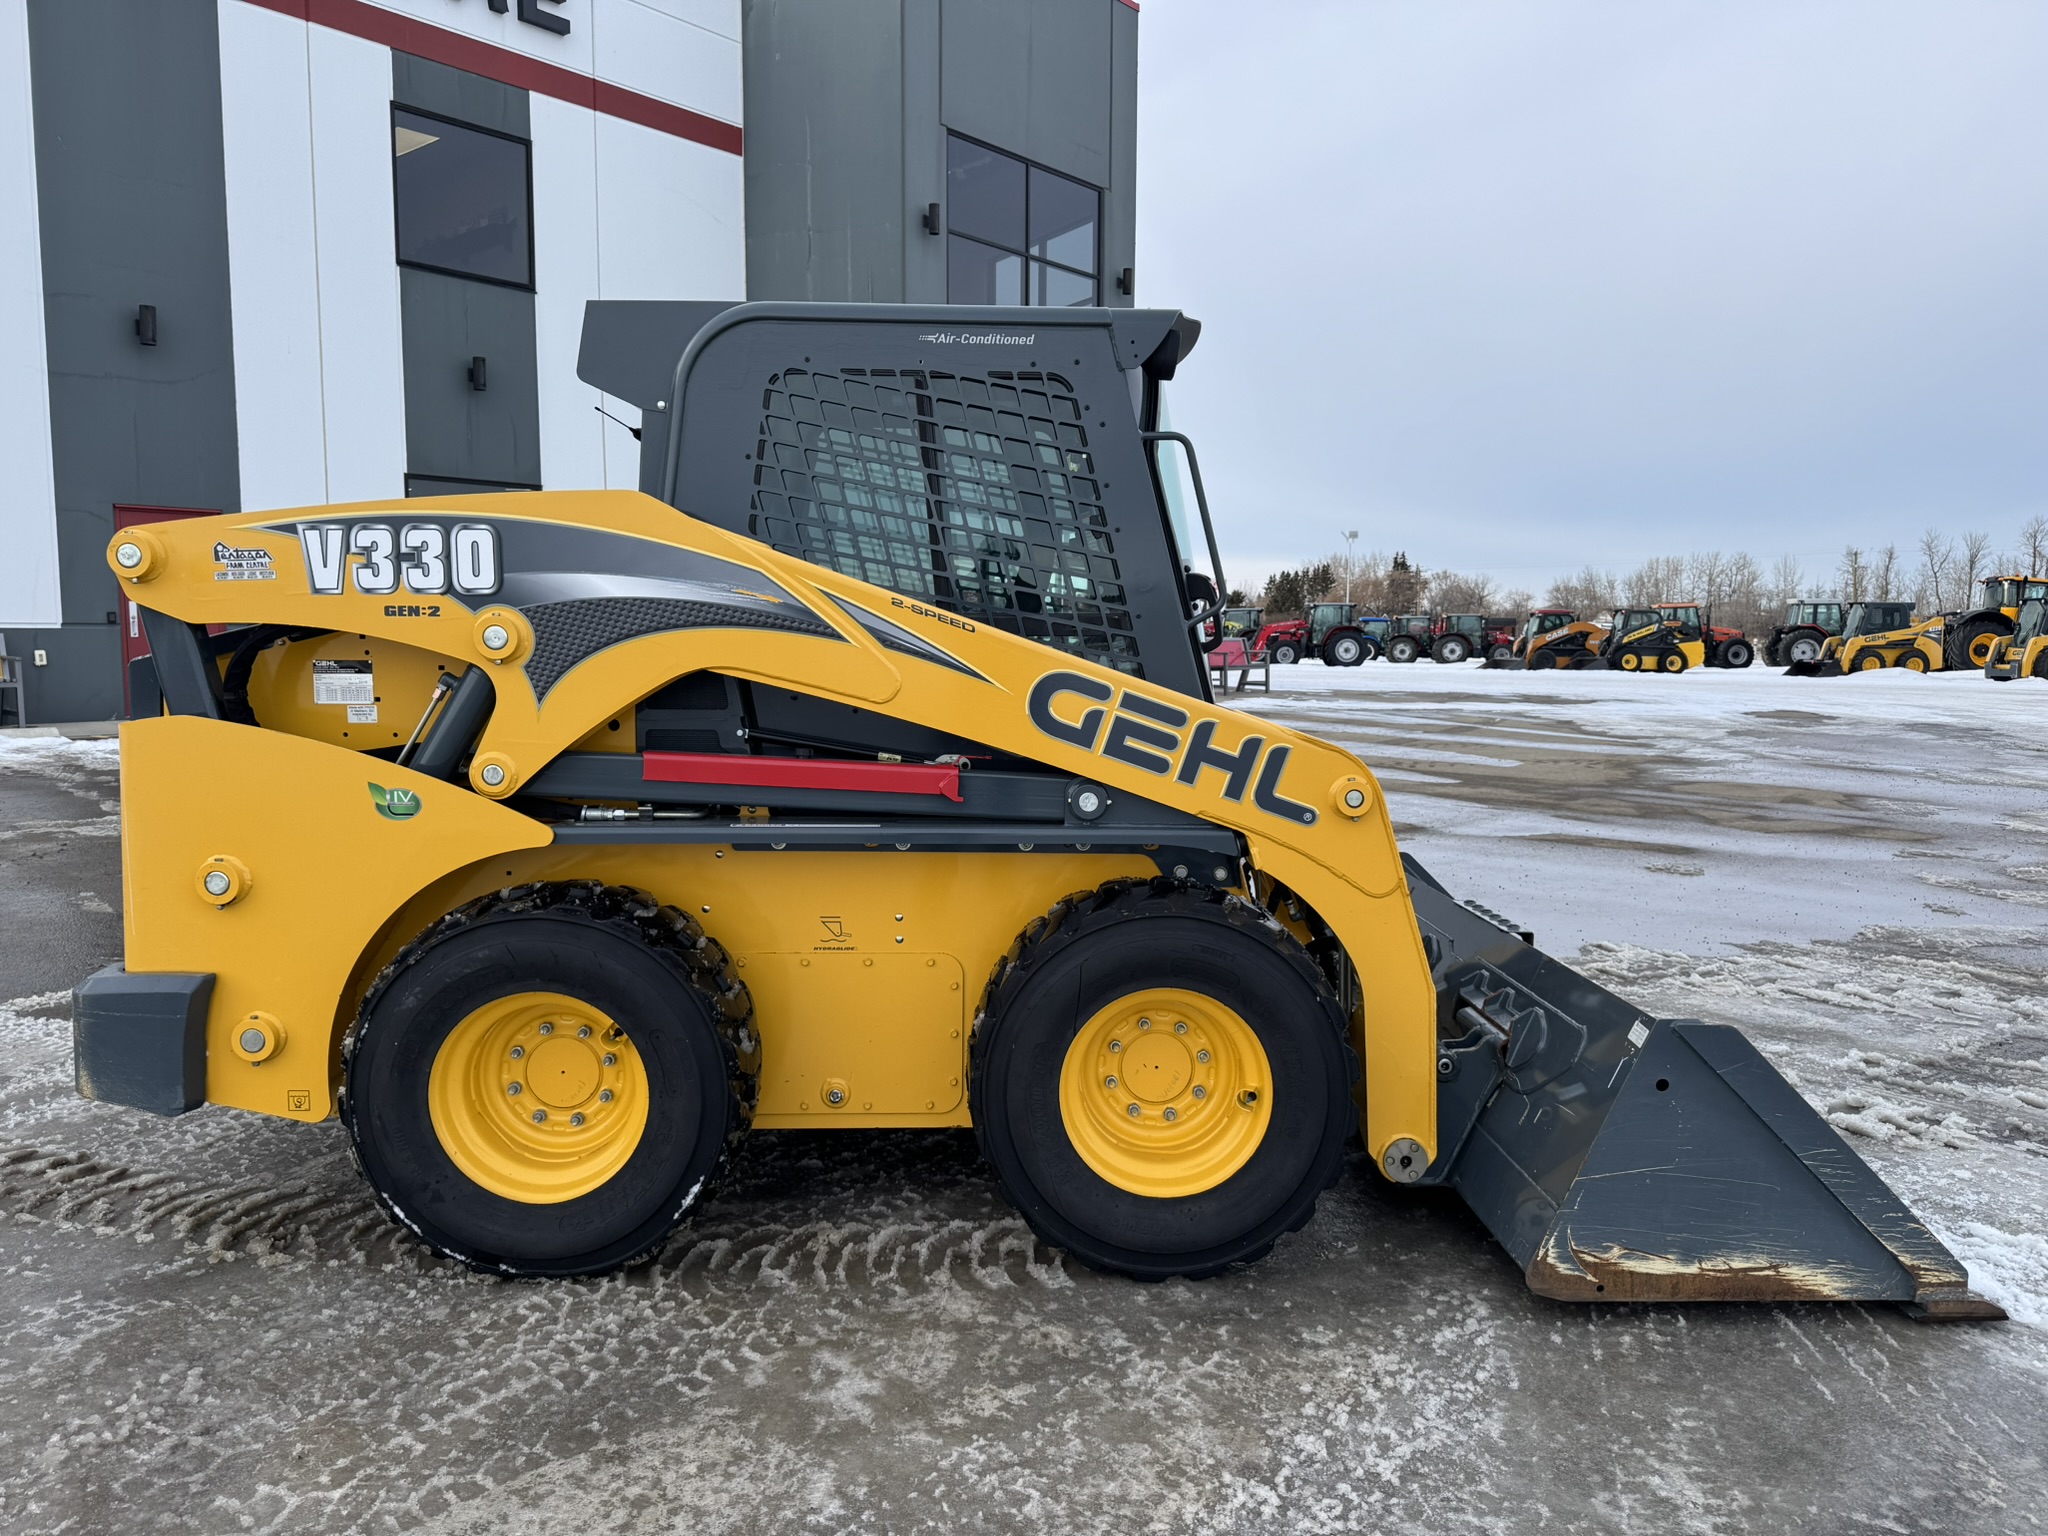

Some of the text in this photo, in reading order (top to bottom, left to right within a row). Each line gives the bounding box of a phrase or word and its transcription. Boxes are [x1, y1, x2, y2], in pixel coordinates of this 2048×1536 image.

[937, 332, 1035, 345] Air-Conditioned
[296, 523, 502, 596] V330
[383, 605, 441, 617] GEN:2
[891, 597, 976, 633] 2-SPEED
[1545, 627, 1569, 641] CASE
[1864, 634, 1890, 643] GEHL
[1025, 669, 1320, 827] GEHL
